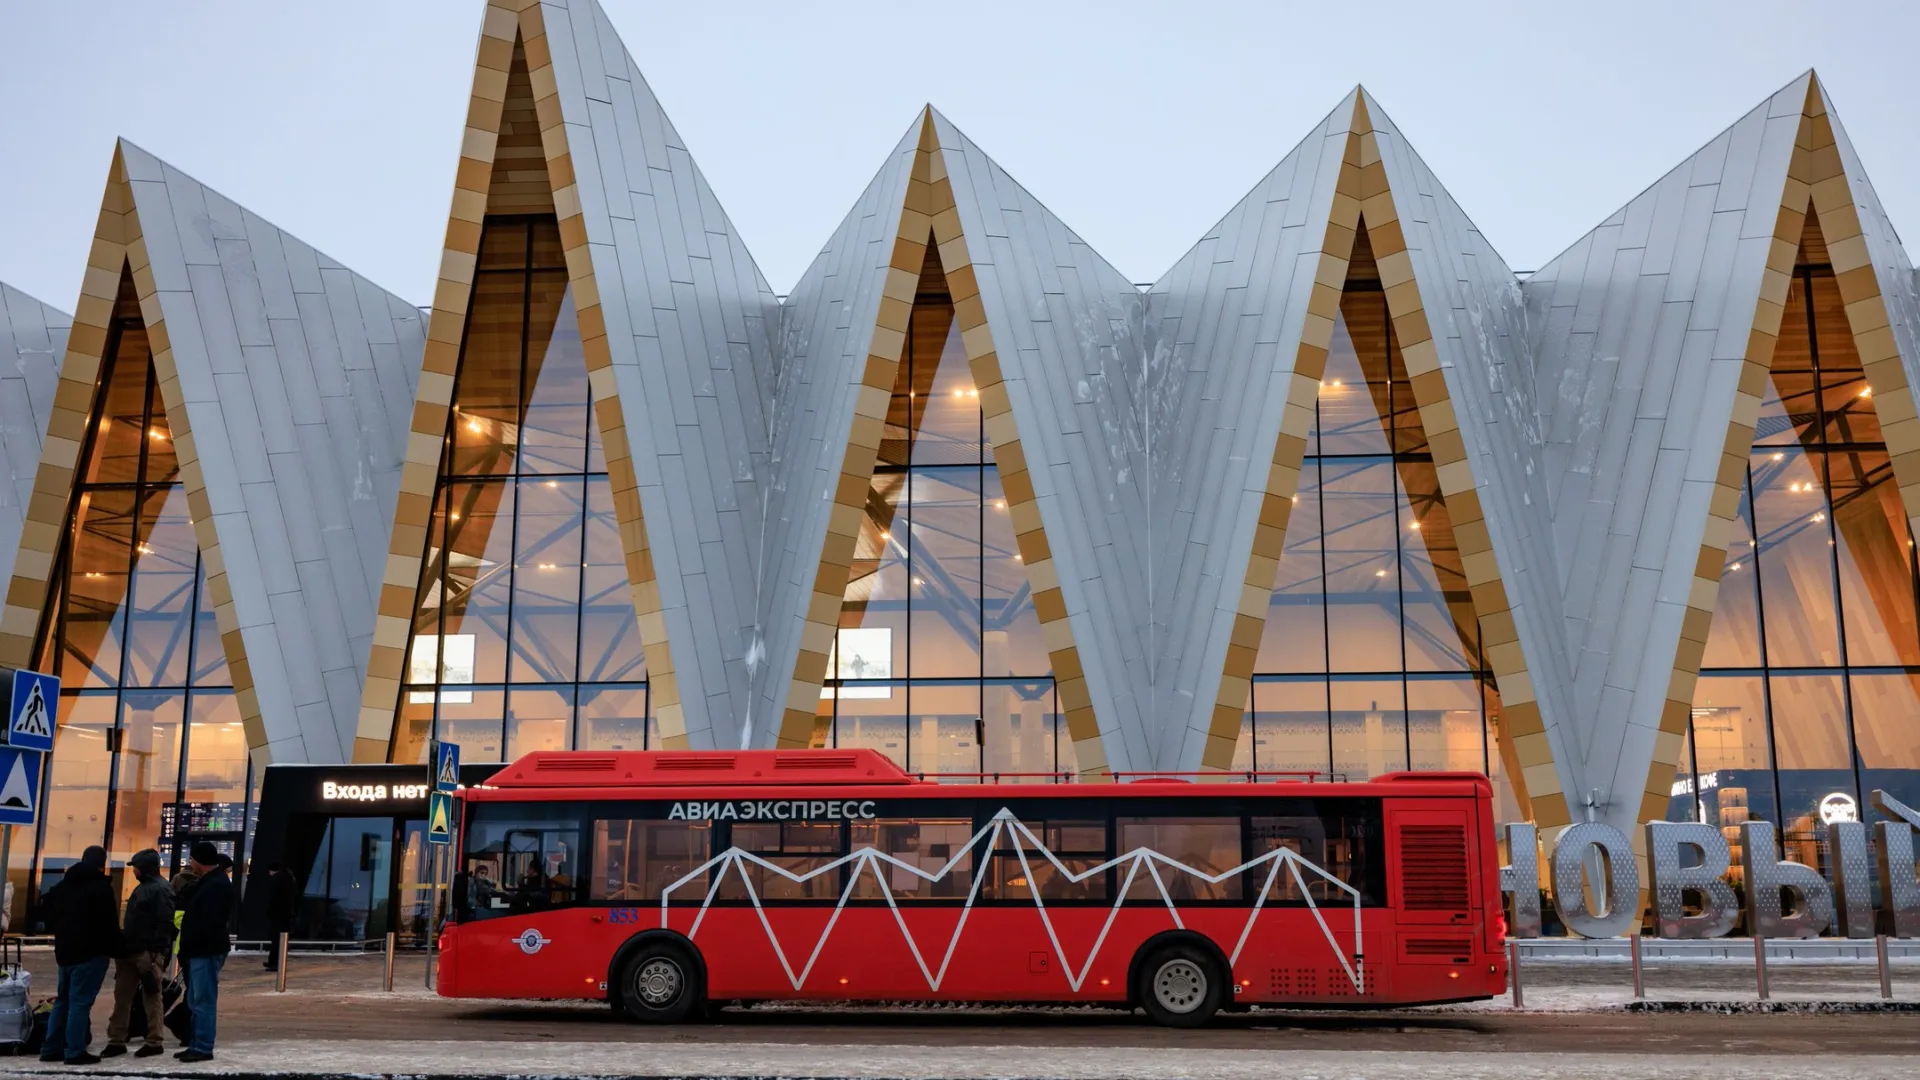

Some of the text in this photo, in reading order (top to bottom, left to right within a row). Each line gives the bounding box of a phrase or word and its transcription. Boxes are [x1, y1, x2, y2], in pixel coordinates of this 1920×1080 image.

[1700, 772, 1718, 789] КОФЕ
[322, 781, 429, 802] Входа нет
[668, 800, 876, 820] АВИАЭКСПРЕСС
[180, 858, 187, 867] 5
[609, 907, 638, 925] 853
